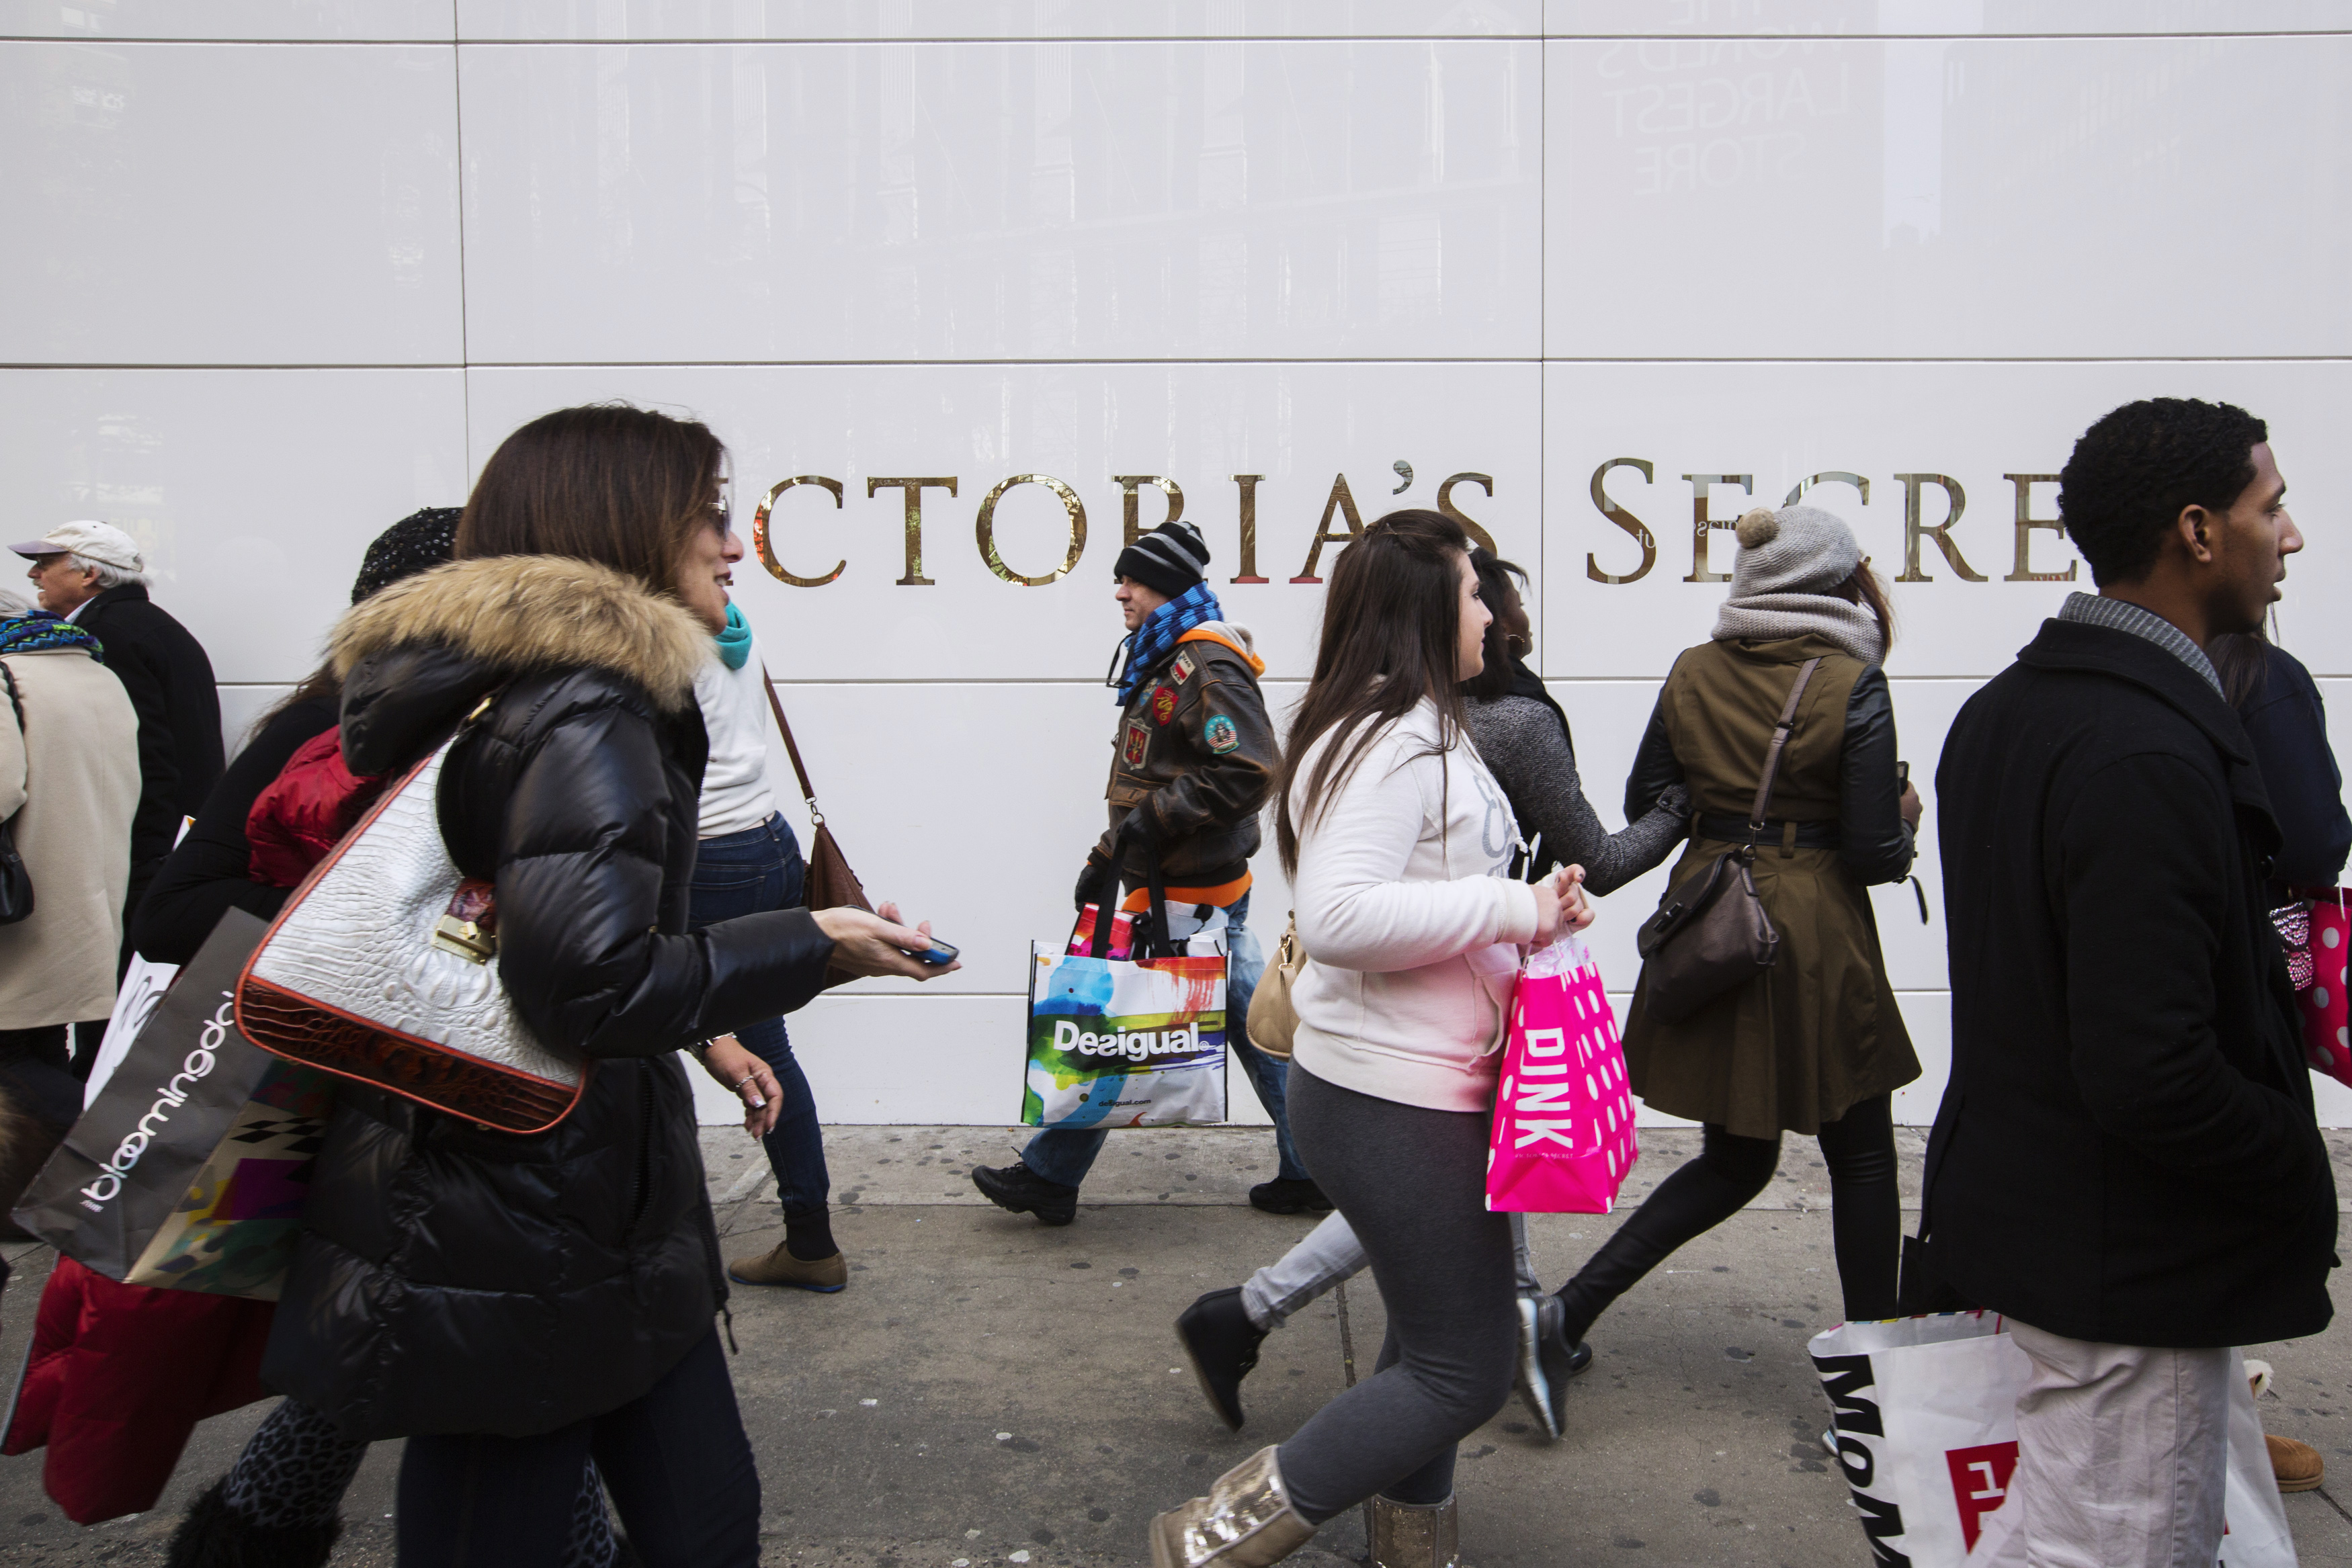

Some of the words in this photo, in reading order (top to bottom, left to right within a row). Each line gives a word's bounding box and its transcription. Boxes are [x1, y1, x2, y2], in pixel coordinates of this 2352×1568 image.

[719, 460, 1498, 586] CTORIA'S
[1587, 458, 2078, 584] SERE
[1053, 1020, 1200, 1061] Desigual
[80, 990, 234, 1201] bloomingda
[1098, 1099, 1151, 1107] desigual.com
